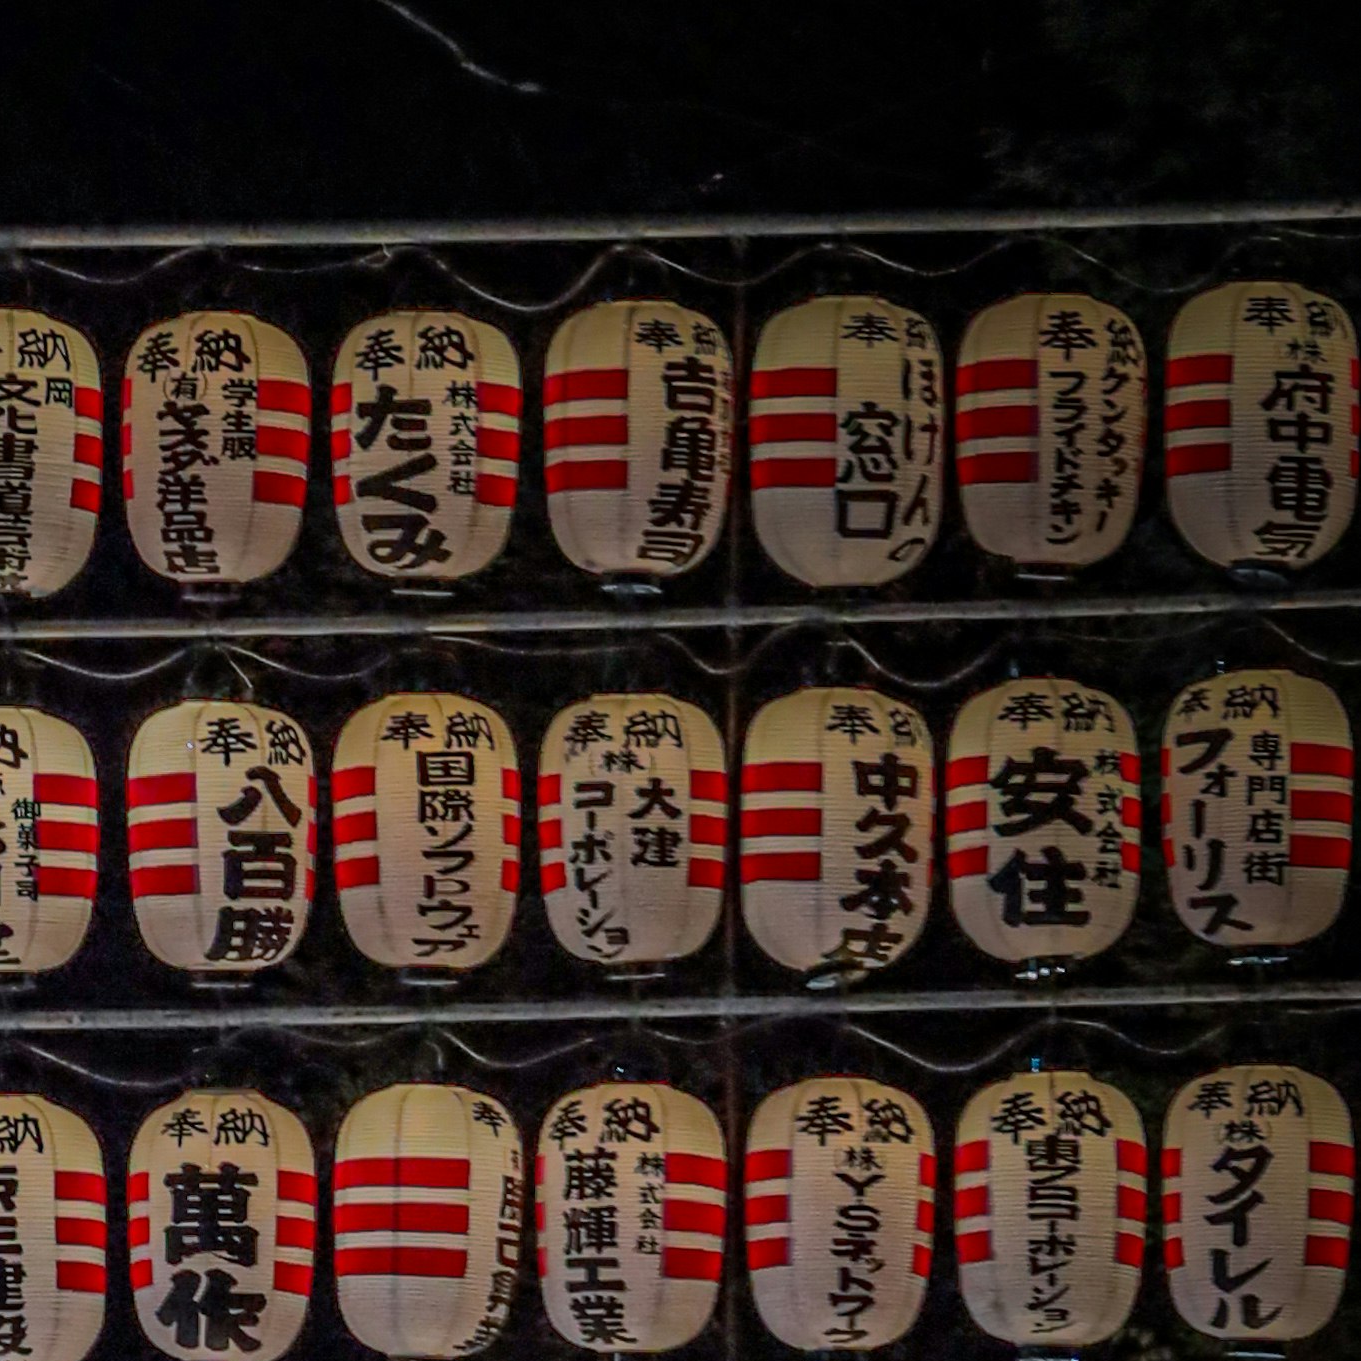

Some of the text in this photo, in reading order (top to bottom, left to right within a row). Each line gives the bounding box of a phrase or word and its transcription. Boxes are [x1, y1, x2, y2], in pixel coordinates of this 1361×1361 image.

[221, 377, 259, 461] 学生服
[354, 388, 448, 568] たくみ
[445, 380, 478, 495] 株式会社
[835, 402, 903, 537] 窓口
[1050, 368, 1086, 545] フライドチキン
[1254, 365, 1333, 556] 府中電気
[997, 694, 1114, 732] 奉納
[12, 798, 42, 902] 御菓子司
[206, 766, 302, 961] 八百勝
[571, 782, 633, 961] コーポレーション
[628, 778, 684, 867] 大建
[989, 748, 1091, 926] 安住
[1092, 750, 1122, 889] 株式会社
[1174, 728, 1252, 936] フォーリス
[1245, 732, 1291, 886] 専門店街
[164, 1108, 269, 1147] 奉納
[634, 1153, 663, 1256] 株式会社
[156, 1163, 268, 1351] 萬作
[1205, 1146, 1283, 1331] タイレル
